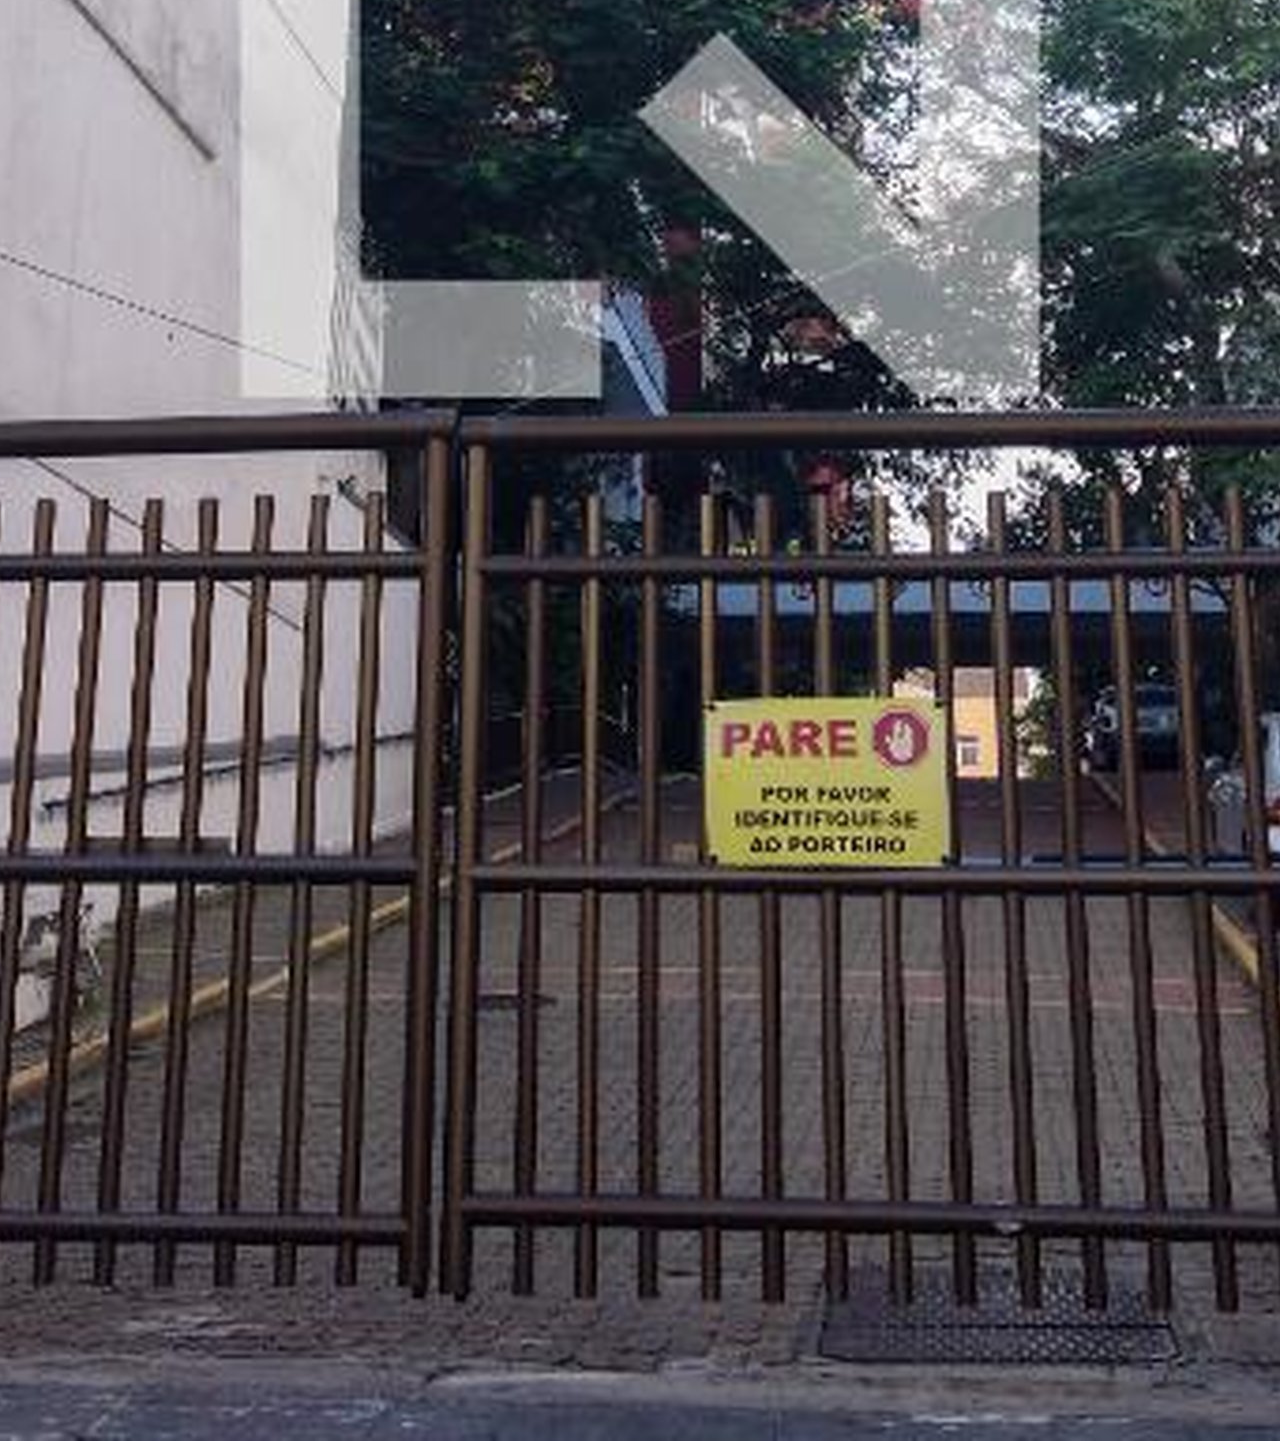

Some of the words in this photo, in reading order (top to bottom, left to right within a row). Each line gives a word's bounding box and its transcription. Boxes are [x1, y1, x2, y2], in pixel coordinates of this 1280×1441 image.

[722, 719, 858, 758] PARE
[761, 786, 808, 804] POR
[818, 786, 891, 804] FAVOR
[750, 836, 782, 853] AO
[788, 835, 907, 854] PORTEIRO
